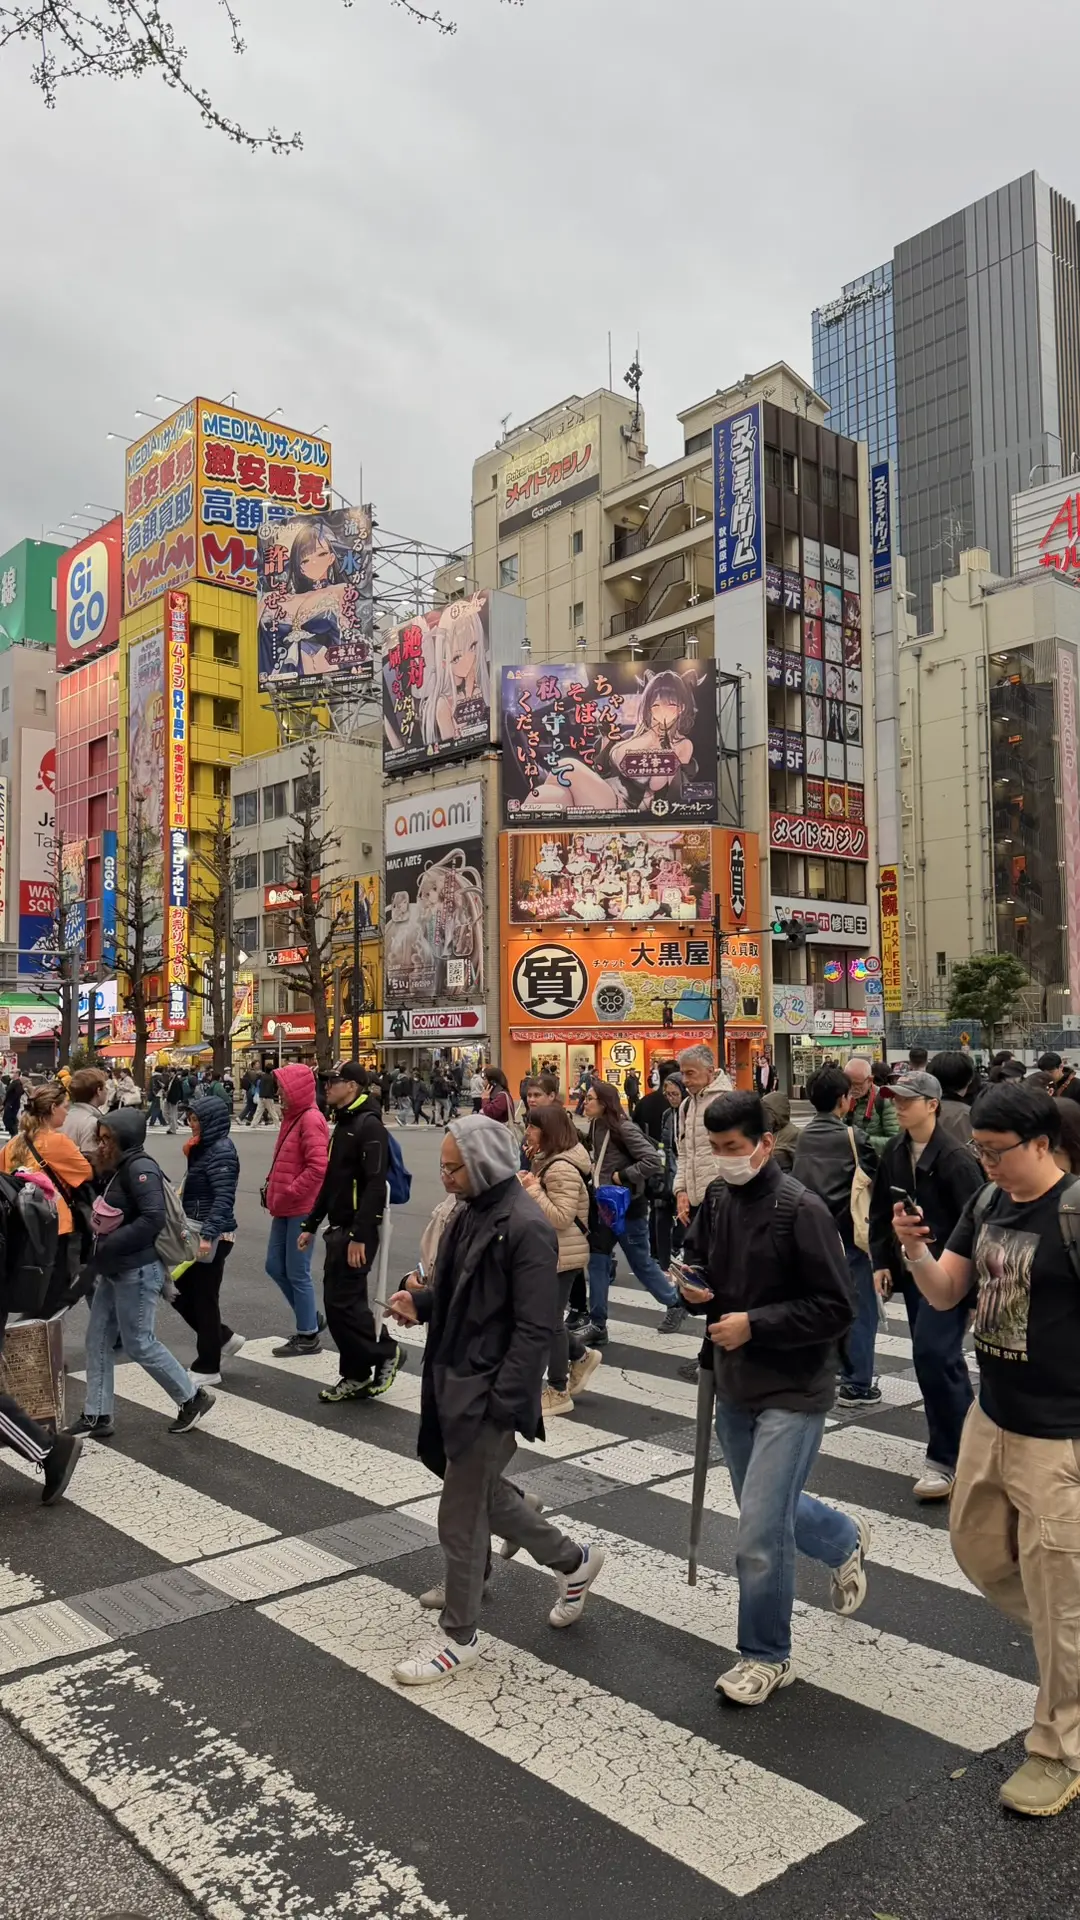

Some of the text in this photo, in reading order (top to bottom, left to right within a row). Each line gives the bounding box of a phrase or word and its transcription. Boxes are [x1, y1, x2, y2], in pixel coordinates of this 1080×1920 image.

[128, 405, 195, 477] MEDIAリサイクル
[203, 411, 328, 467] MEDIAリサイクル
[128, 440, 194, 515] 激安販売
[204, 441, 327, 508] 激安販売
[505, 443, 592, 510] メイドカジノ
[127, 482, 193, 560] 高額買取
[718, 526, 728, 574] 秋葉原店
[69, 556, 92, 602] Gi
[215, 570, 255, 588] ムーラン
[784, 588, 801, 609] 7F
[68, 590, 105, 642] GO
[402, 624, 426, 690] 絶対
[785, 668, 802, 687] 6F
[567, 683, 603, 772] そばにいて、
[593, 674, 625, 741] ちゃんと
[536, 675, 574, 787] 私に守らせて
[786, 750, 803, 769] 5F
[394, 802, 471, 838] amiami
[773, 818, 867, 854] メイドカジノ
[104, 855, 115, 891] GiGO
[592, 959, 626, 968] チケット
[630, 940, 711, 968] 大黒屋
[868, 960, 877, 968] 40
[522, 954, 579, 1011] 質
[868, 982, 876, 993] P
[412, 1013, 462, 1029] COMIC ZIN
[613, 1045, 632, 1064] 質
[1003, 1350, 1018, 1360] SKY
